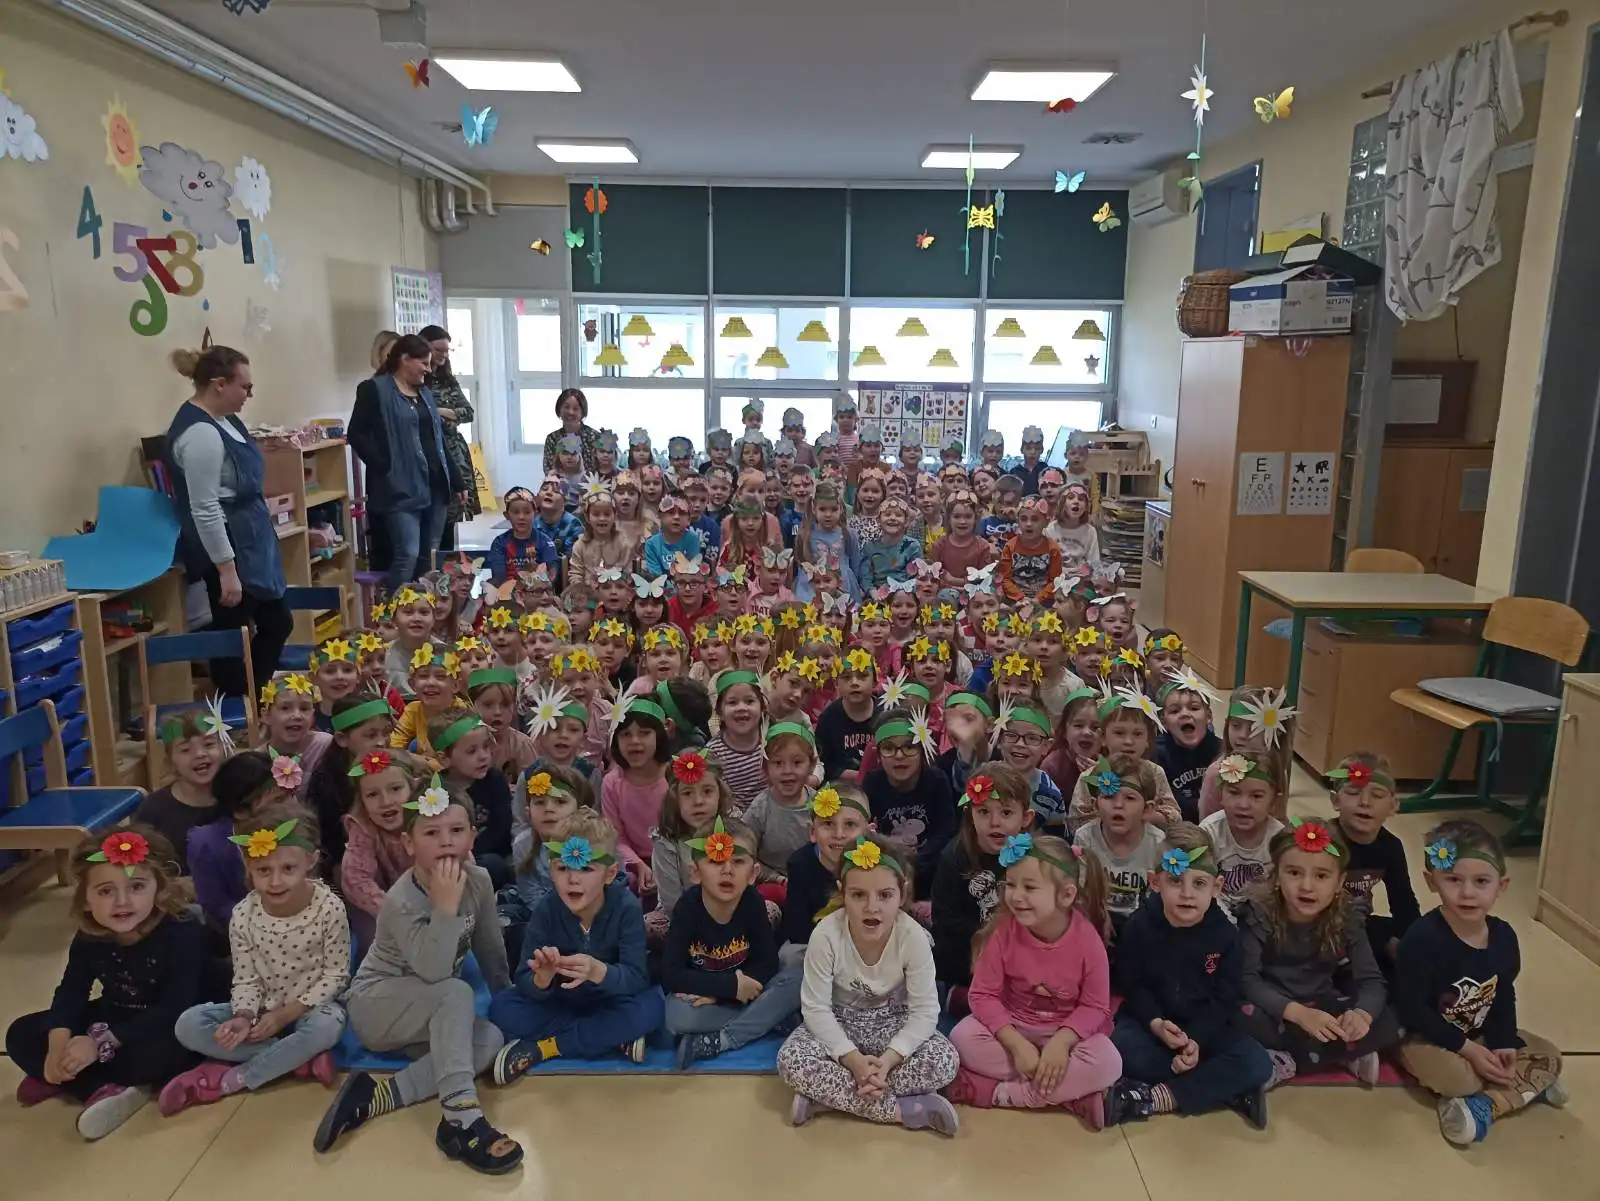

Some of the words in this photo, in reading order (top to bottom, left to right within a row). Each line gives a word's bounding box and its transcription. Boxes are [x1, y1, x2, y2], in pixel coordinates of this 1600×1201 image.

[77, 185, 102, 259] 4
[113, 222, 148, 282] 5
[1256, 457, 1267, 472] E
[1263, 474, 1271, 482] P
